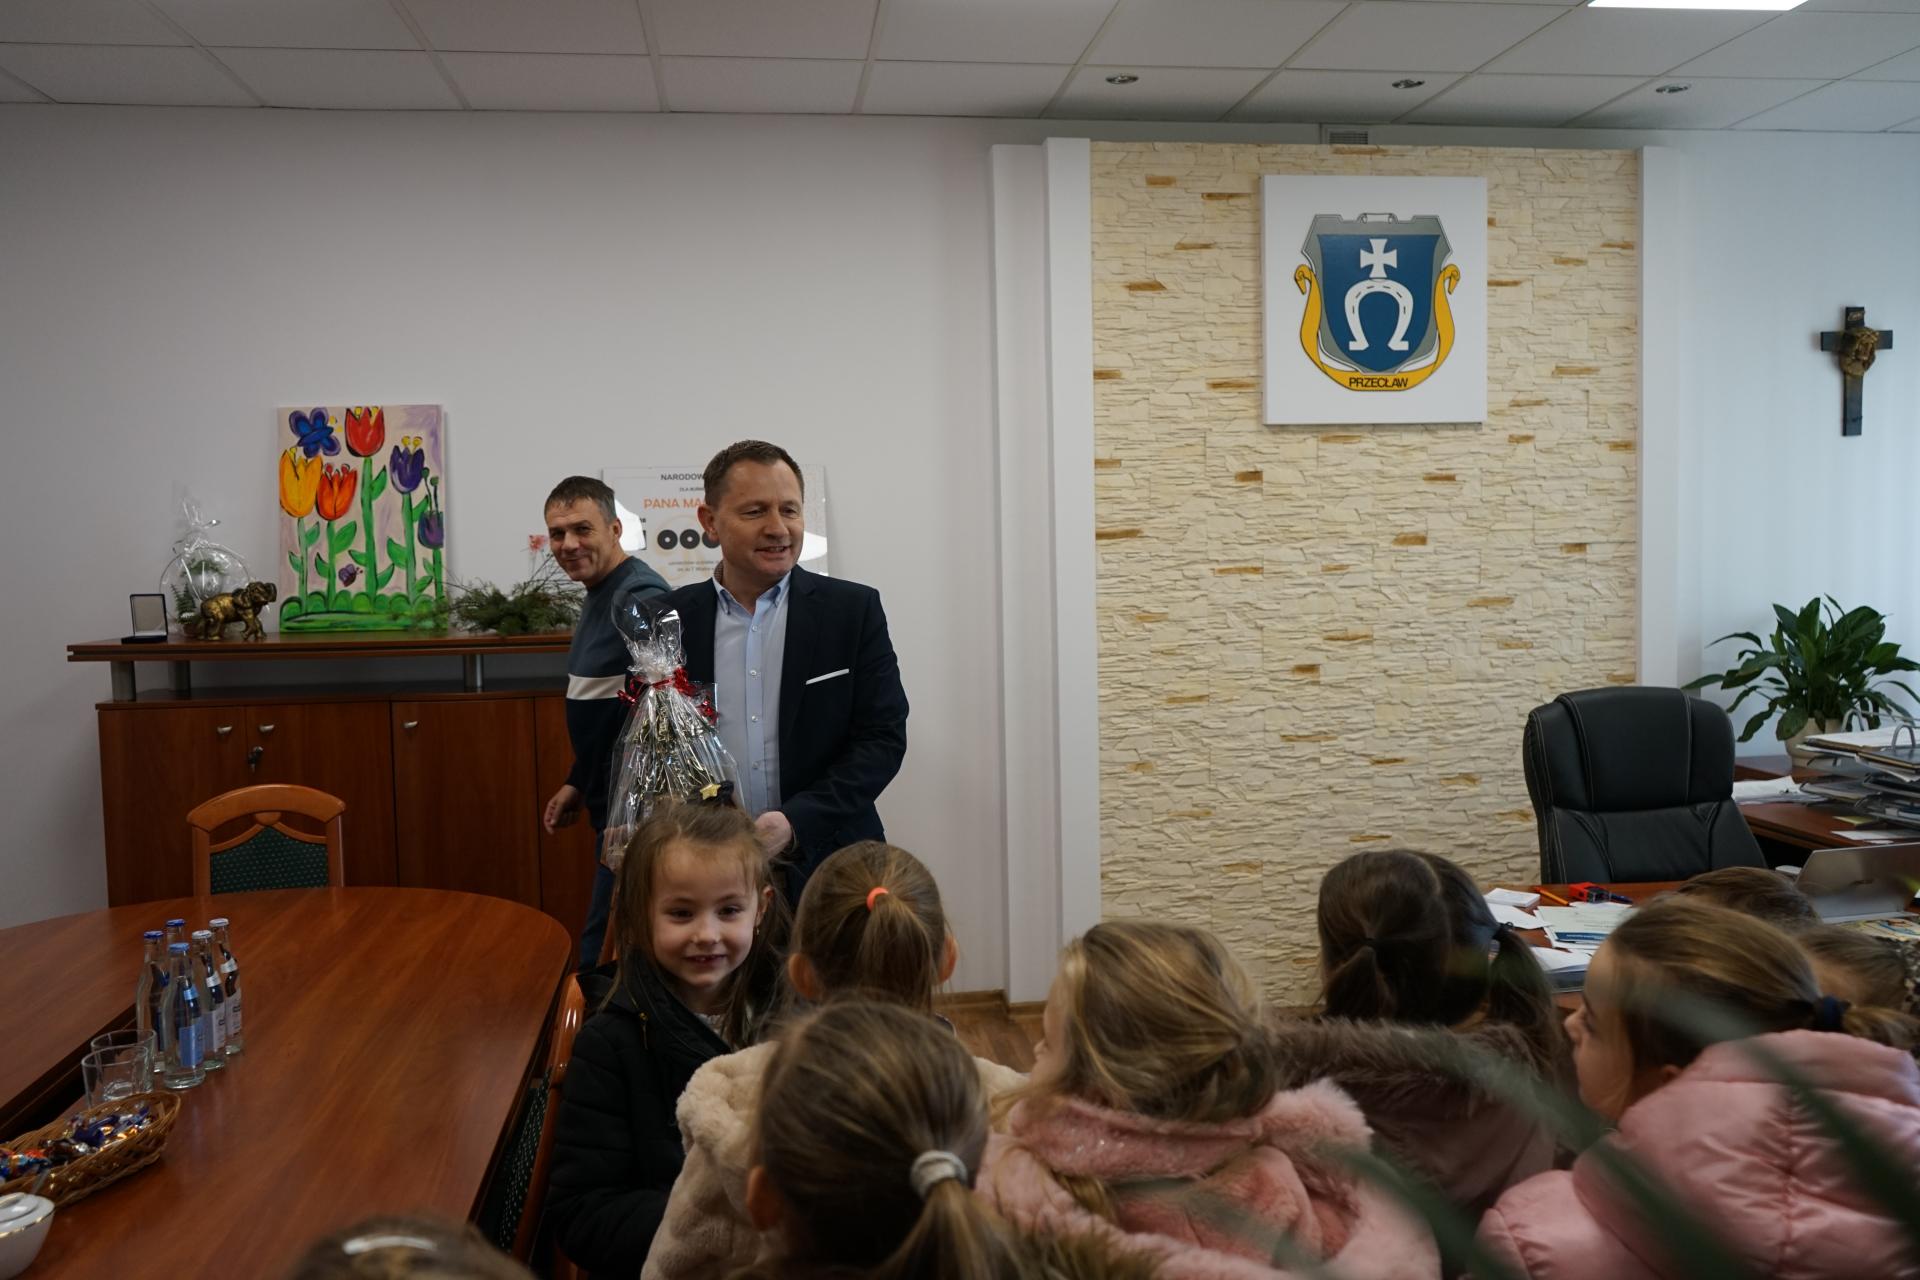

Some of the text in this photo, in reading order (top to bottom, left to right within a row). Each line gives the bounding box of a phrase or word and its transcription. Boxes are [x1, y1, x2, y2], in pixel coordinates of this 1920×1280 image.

[1349, 377, 1409, 388] PRZECŁAW
[660, 473, 705, 481] NARODOW
[643, 497, 703, 509] PANA MA
